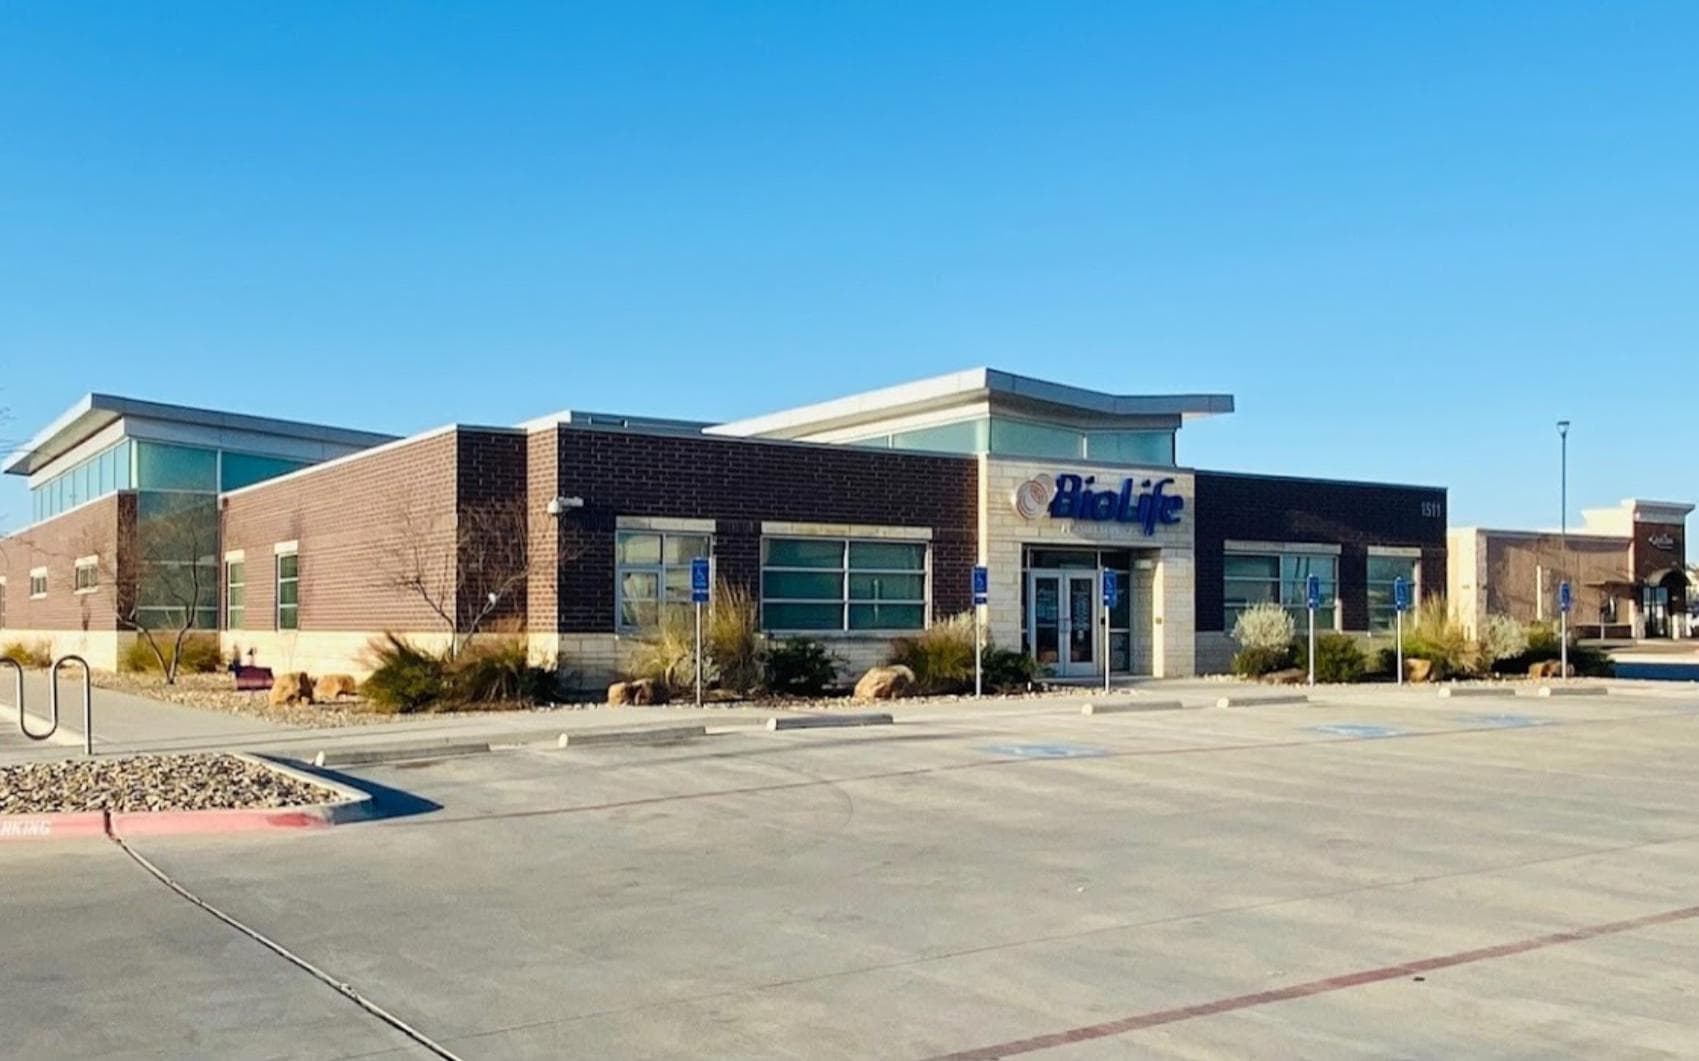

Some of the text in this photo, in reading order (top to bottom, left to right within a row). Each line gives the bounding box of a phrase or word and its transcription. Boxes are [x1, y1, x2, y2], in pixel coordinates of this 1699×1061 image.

[1048, 473, 1184, 537] BioLife
[1421, 501, 1441, 518] 1511
[0, 819, 50, 836] RKING
